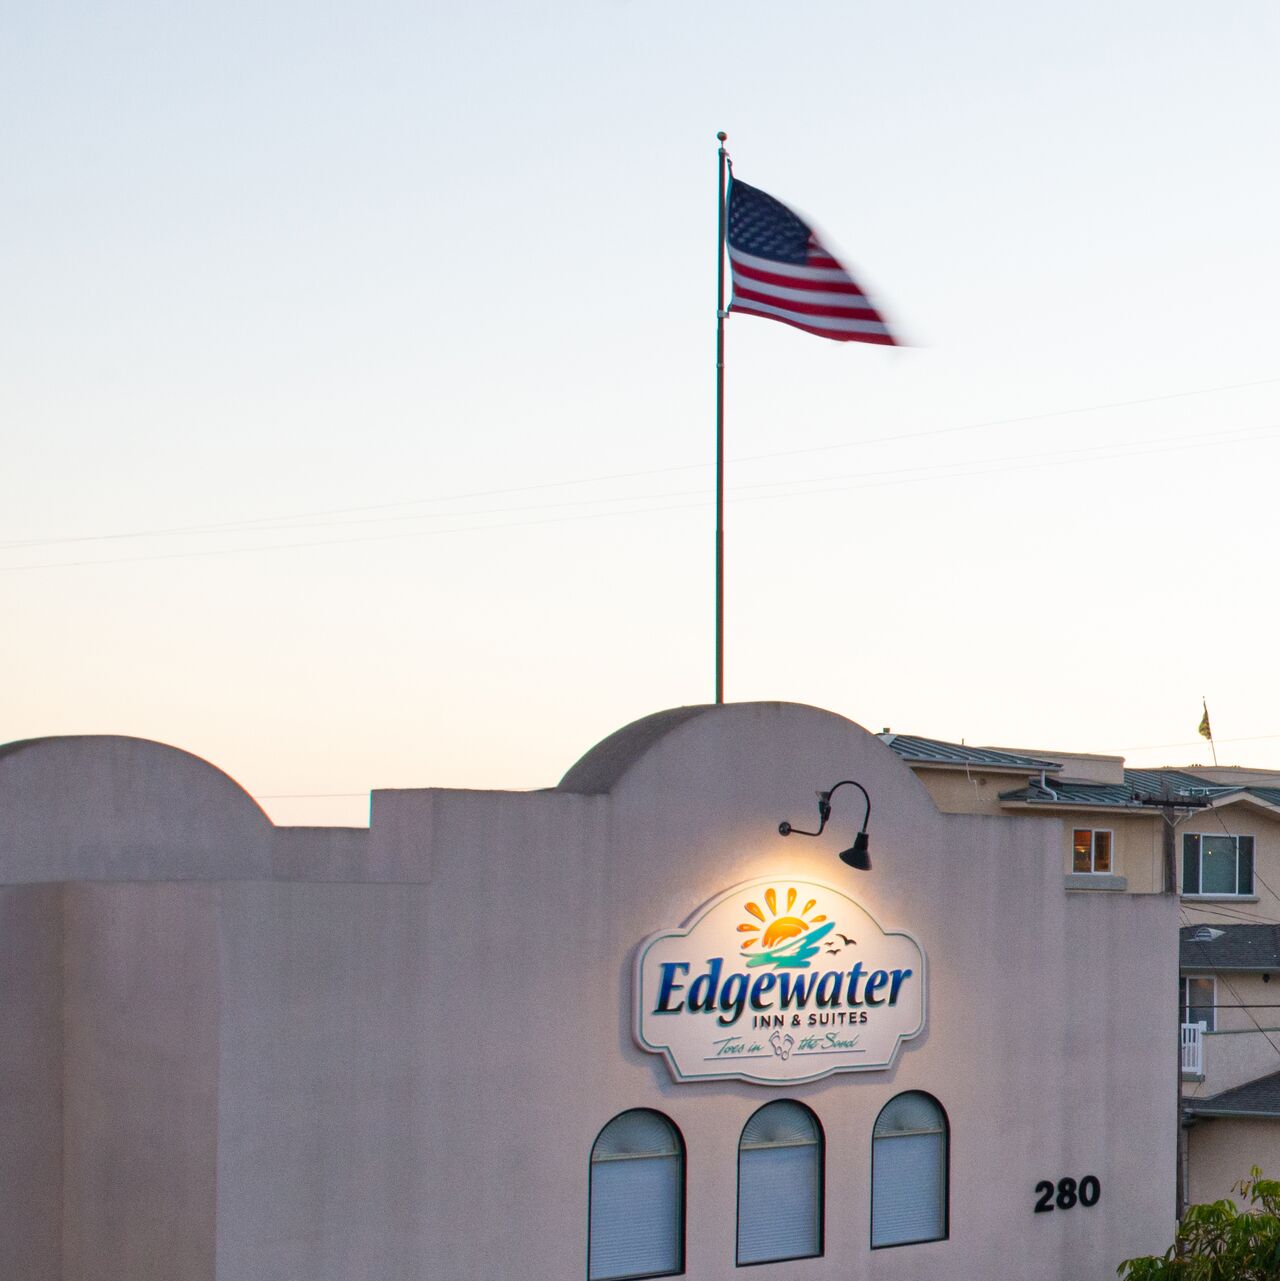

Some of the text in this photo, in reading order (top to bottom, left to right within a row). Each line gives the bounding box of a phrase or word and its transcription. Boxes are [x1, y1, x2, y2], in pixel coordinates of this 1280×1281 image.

[651, 957, 913, 1027] Edgewater
[753, 1011, 869, 1029] INN & SUITES
[712, 1031, 861, 1057] Toes in the Sand
[1033, 1174, 1101, 1214] 280
